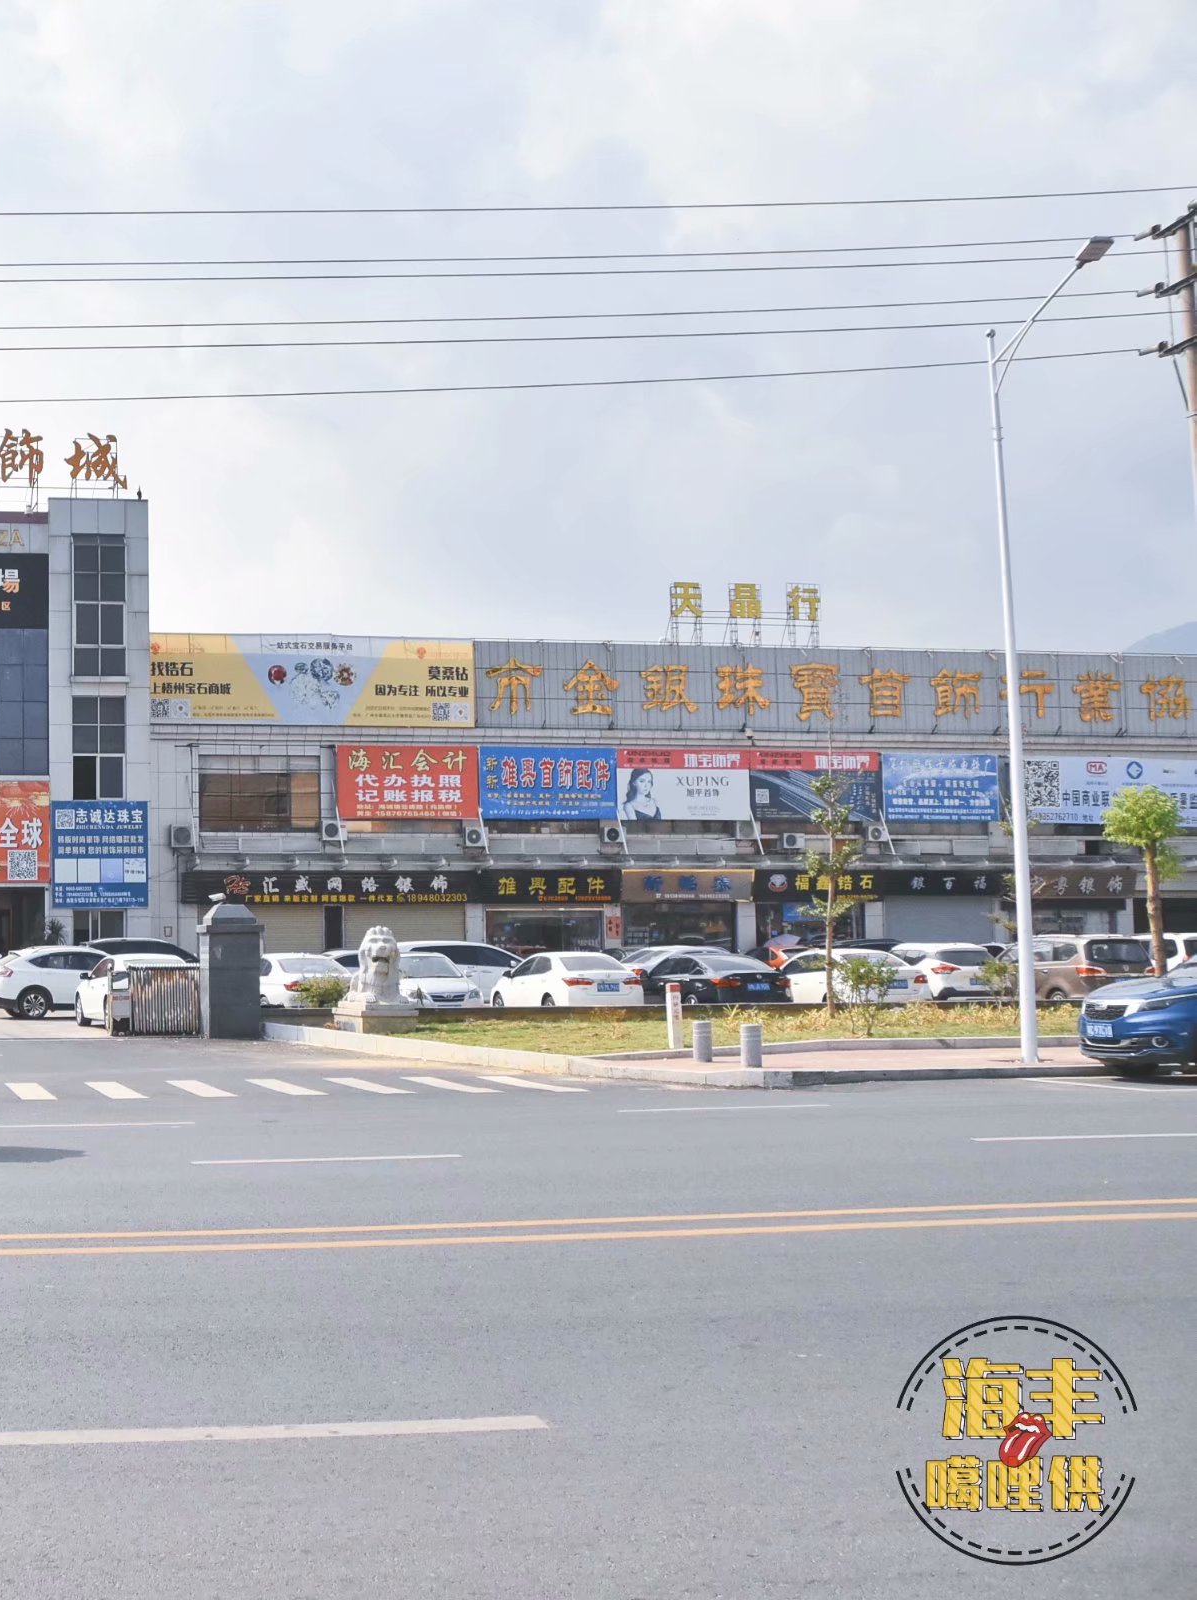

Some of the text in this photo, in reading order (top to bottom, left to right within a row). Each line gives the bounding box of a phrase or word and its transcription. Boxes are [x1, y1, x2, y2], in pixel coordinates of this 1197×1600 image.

[671, 582, 820, 622] 天晶行
[268, 641, 353, 651] 一站式宝石交易服务平台
[150, 661, 194, 677] 找锆石
[428, 666, 469, 681] 莫桑钻
[151, 682, 232, 695] 上梧州宝石商城
[375, 684, 469, 698] 因为专注 所以专业
[348, 748, 468, 773] 海汇会计
[355, 774, 463, 788] 代办执照
[676, 776, 730, 787] XUPING
[355, 789, 463, 803] 记账报税
[1062, 789, 1118, 807] 中国商业联
[76, 808, 143, 824] 志诚达珠宝
